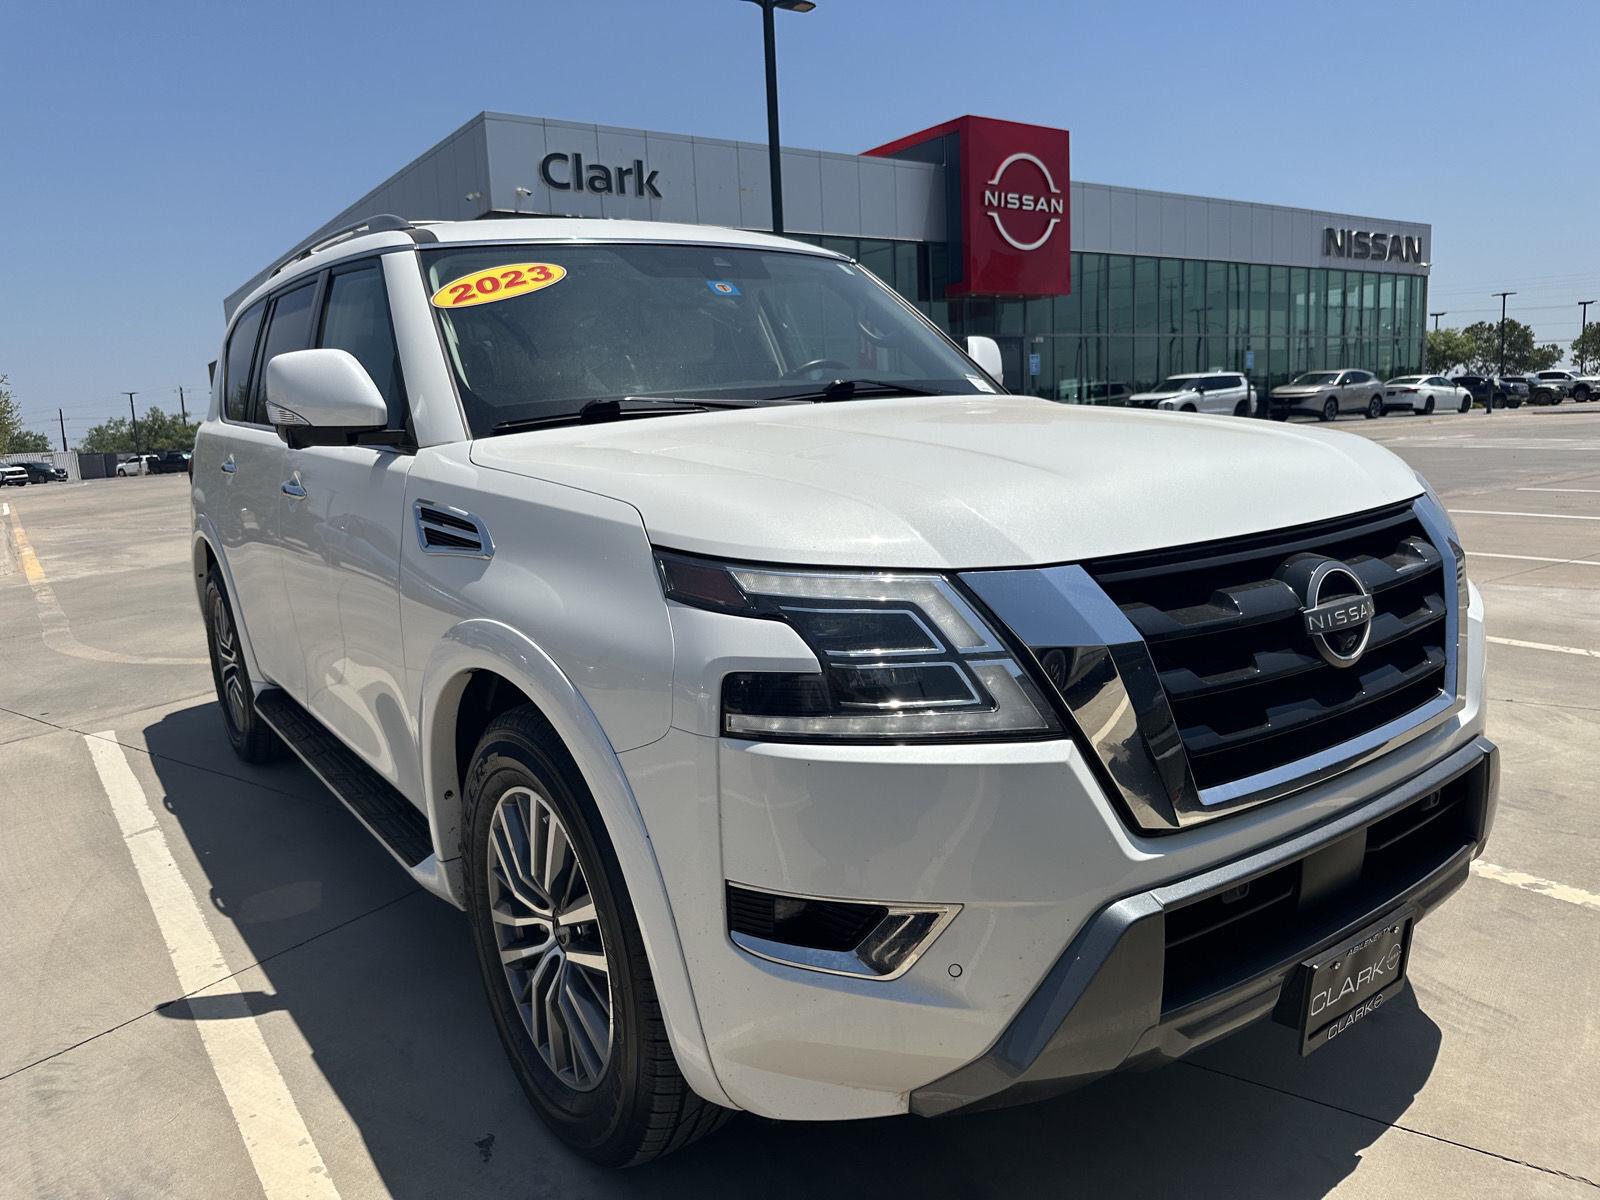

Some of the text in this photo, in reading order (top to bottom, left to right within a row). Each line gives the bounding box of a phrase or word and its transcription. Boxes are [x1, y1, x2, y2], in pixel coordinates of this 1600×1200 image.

[539, 152, 662, 199] Clark
[985, 189, 1063, 214] NISSAN
[1323, 227, 1422, 263] NISSAN
[449, 266, 554, 304] 2023
[1309, 601, 1375, 631] NISSAN
[1311, 956, 1384, 1016] CLARK
[1327, 1002, 1373, 1040] CLARK
